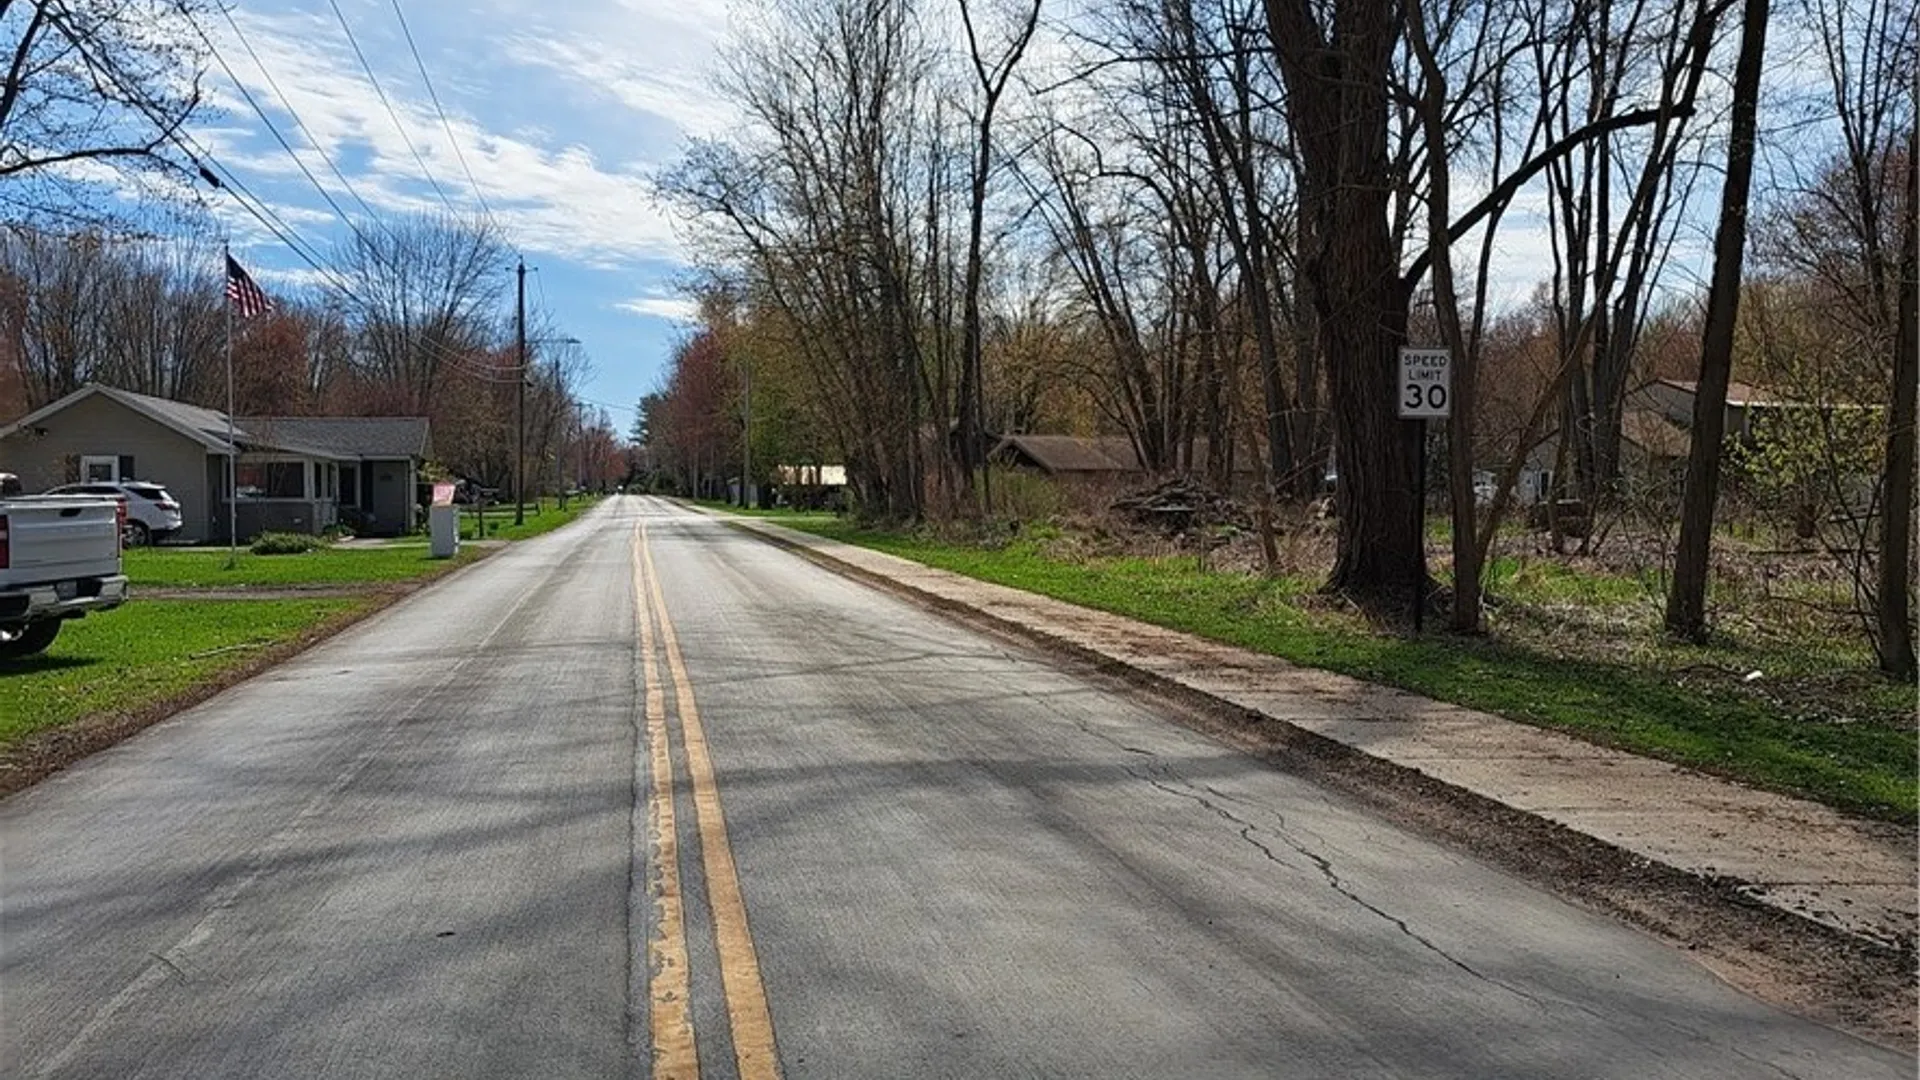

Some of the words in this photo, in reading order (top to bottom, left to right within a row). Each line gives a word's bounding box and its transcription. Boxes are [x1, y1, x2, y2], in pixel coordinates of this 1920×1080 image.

[1404, 354, 1447, 367] SPEED
[1408, 369, 1442, 381] LIMIT
[1404, 384, 1447, 409] 30
